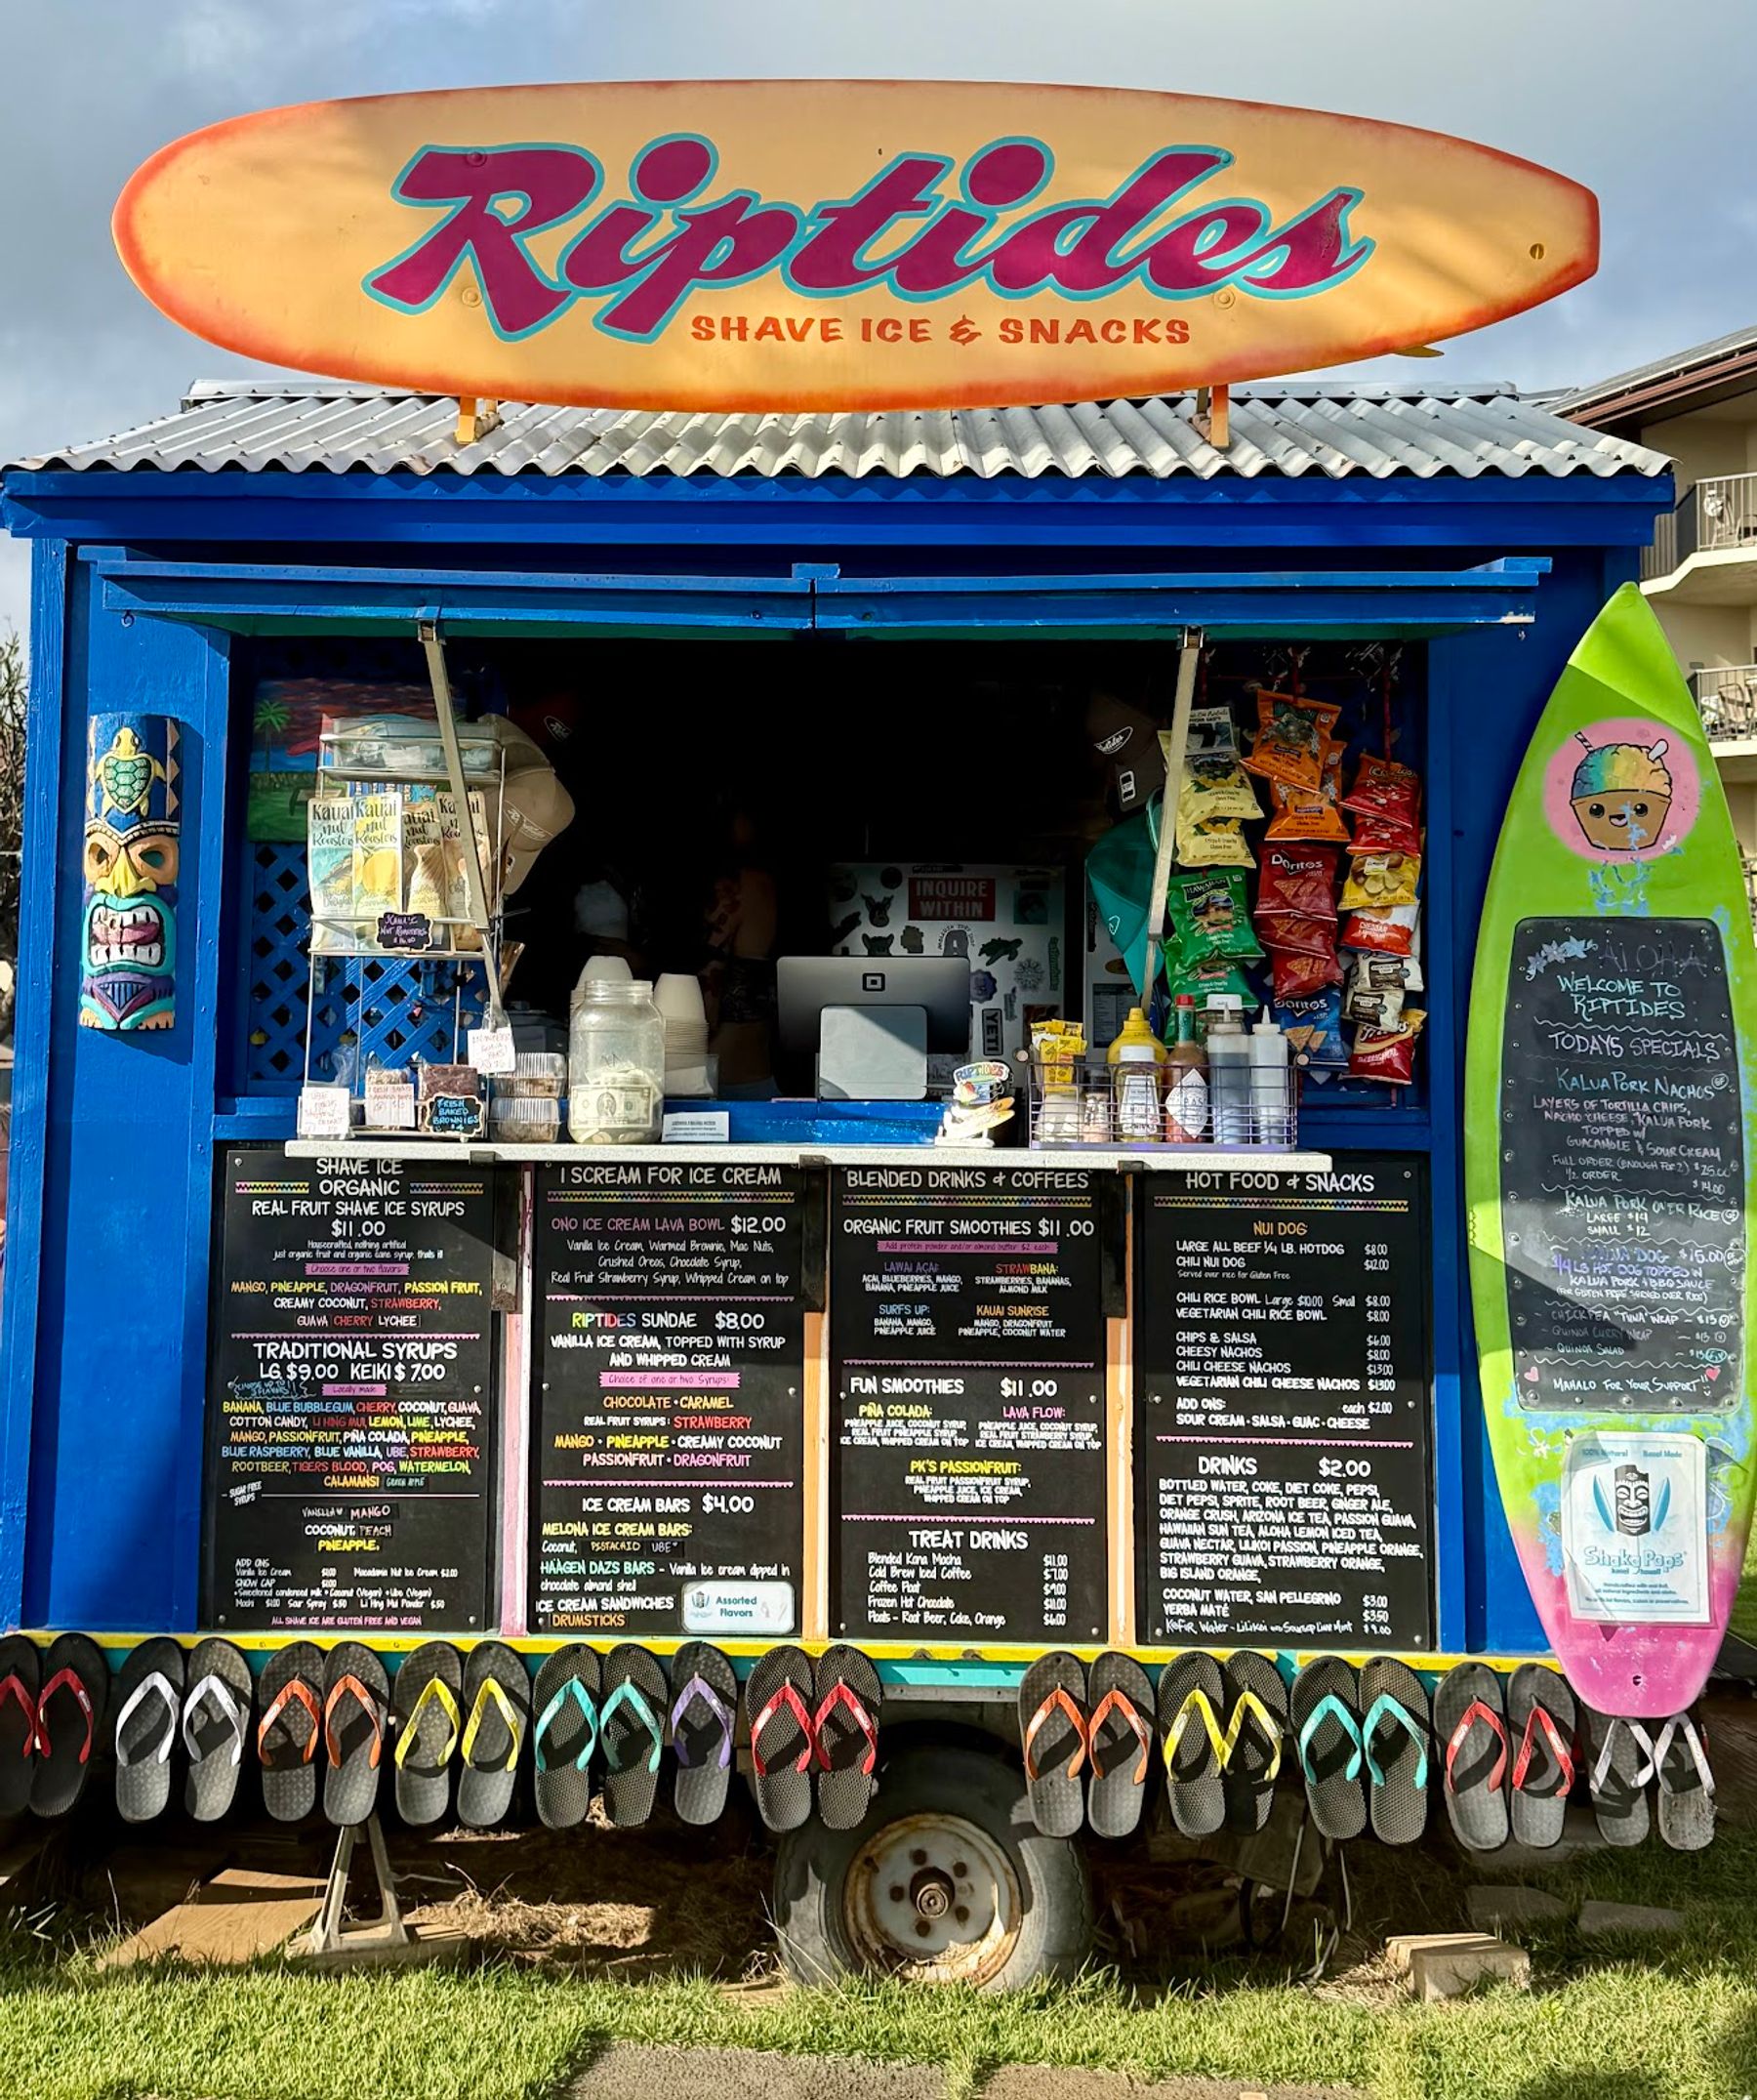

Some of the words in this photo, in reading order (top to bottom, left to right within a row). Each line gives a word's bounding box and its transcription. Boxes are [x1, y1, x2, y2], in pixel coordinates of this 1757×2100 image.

[362, 132, 1377, 344] Riptides
[691, 316, 843, 342] SHAVE
[861, 318, 931, 343] ICE
[949, 314, 982, 347] &
[999, 318, 1191, 345] SNACKS
[356, 799, 397, 817] Kauai
[404, 808, 435, 825] auai
[1271, 853, 1323, 870] Doritos
[916, 881, 987, 897] INQUIRE
[919, 901, 983, 917] WITHIN
[1557, 975, 1644, 993] WELCOME
[1650, 981, 1681, 998] TO
[1572, 994, 1686, 1021] RIPTIDES
[986, 1012, 999, 1051] YETI
[1548, 1031, 1624, 1058] TODAYS
[1630, 1037, 1720, 1063] SPECIALS
[316, 1158, 369, 1174] SHAVE
[377, 1158, 403, 1174] ICE
[560, 1168, 564, 1183] I
[571, 1167, 641, 1184] SCREAM
[647, 1168, 682, 1184] FOR
[689, 1168, 715, 1184] ICE
[722, 1168, 781, 1185] CREAM
[847, 1170, 921, 1188] BLENDED
[928, 1170, 986, 1188] DRINKS
[1011, 1172, 1089, 1189] COFFEES
[1185, 1172, 1224, 1189] HOT
[1230, 1173, 1279, 1191] FOOD
[1306, 1173, 1374, 1193] SNACKS
[320, 1179, 400, 1195] ORGANIC
[252, 1201, 288, 1216] REAL
[292, 1201, 330, 1216] FRUIT
[336, 1201, 380, 1216] SHAVE
[385, 1202, 406, 1215] ICE
[411, 1203, 465, 1216] SYRUPS
[551, 1217, 578, 1231] ONO
[583, 1218, 603, 1230] ICE
[607, 1218, 651, 1231] CREAM
[655, 1218, 684, 1231] LAVA
[689, 1218, 724, 1231] BOWL
[731, 1215, 786, 1234] $12.00
[843, 1218, 901, 1234] ORGANIC
[906, 1219, 944, 1234] FRUIT
[950, 1219, 1031, 1236] SMOOTHIES
[1253, 1220, 1274, 1236] NUI
[1176, 1240, 1208, 1252] LARGE
[1212, 1241, 1231, 1253] ALL
[1234, 1242, 1261, 1254] BEEF
[1300, 1243, 1344, 1255] HOTDOG
[231, 1281, 267, 1295] MANGO,
[271, 1281, 328, 1295] PINEAPPLE,
[404, 1281, 448, 1293] PASSION
[451, 1282, 482, 1296] FRUIT,
[273, 1298, 314, 1309] CREAMY
[879, 1304, 911, 1315] SURFS
[976, 1305, 1004, 1316] KAUAI
[1007, 1306, 1049, 1316] SUNRISE
[297, 1315, 328, 1326] GUAVA
[334, 1315, 373, 1326] CHERRY
[379, 1316, 417, 1326] LYCHEE
[572, 1313, 636, 1328] RIPTIDES
[642, 1312, 697, 1328] SUNDAE
[551, 1336, 593, 1347] VANILLA
[597, 1336, 616, 1347] ICE
[619, 1336, 661, 1349] CREAM,
[666, 1336, 713, 1348] TOPPED
[716, 1337, 745, 1348] WITH
[748, 1338, 785, 1349] SYRUP
[1176, 1332, 1206, 1343] CHIPS
[1224, 1332, 1257, 1344] SALSA
[254, 1341, 377, 1359] TRADITIONAL
[382, 1342, 457, 1359] SYRUPS
[1176, 1346, 1217, 1357] CHEESY
[1220, 1347, 1263, 1359] NACHOS
[609, 1353, 633, 1367] AND
[635, 1353, 687, 1367] WHIPPED
[691, 1355, 730, 1367] CREAM
[350, 1363, 390, 1380] KEIKI
[850, 1377, 877, 1394] FUN
[881, 1377, 964, 1394] SMOOTHIES
[266, 1402, 292, 1413] BLUE
[603, 1396, 672, 1409] CHOCOLATE
[679, 1397, 734, 1409] CARAMEL
[1003, 1406, 1029, 1419] LAVA
[1176, 1414, 1205, 1425] SOUR
[1208, 1415, 1245, 1427] CREAM
[1251, 1416, 1287, 1427] SALSA
[1292, 1416, 1320, 1428] GUAC
[1327, 1418, 1370, 1429] CHEESE
[584, 1454, 664, 1466] PASSIONFRUIT
[674, 1455, 752, 1466] DRAGONFRUIT
[1199, 1455, 1257, 1475] DRINKS
[1319, 1457, 1370, 1478] $2.00
[324, 1476, 380, 1488] CALAMANSI
[583, 1498, 603, 1511] ICE
[607, 1498, 652, 1512] CREAM
[656, 1498, 691, 1512] BARS
[909, 1530, 963, 1548] TREAT
[970, 1530, 1028, 1549] DRINKS
[1584, 1545, 1642, 1574] Shaka
[890, 1568, 915, 1580] Brew
[941, 1568, 972, 1580] Coffee
[716, 1596, 757, 1605] Assorted
[552, 1615, 625, 1626] DRUMSTICKS
[720, 1608, 754, 1617] Flavors
